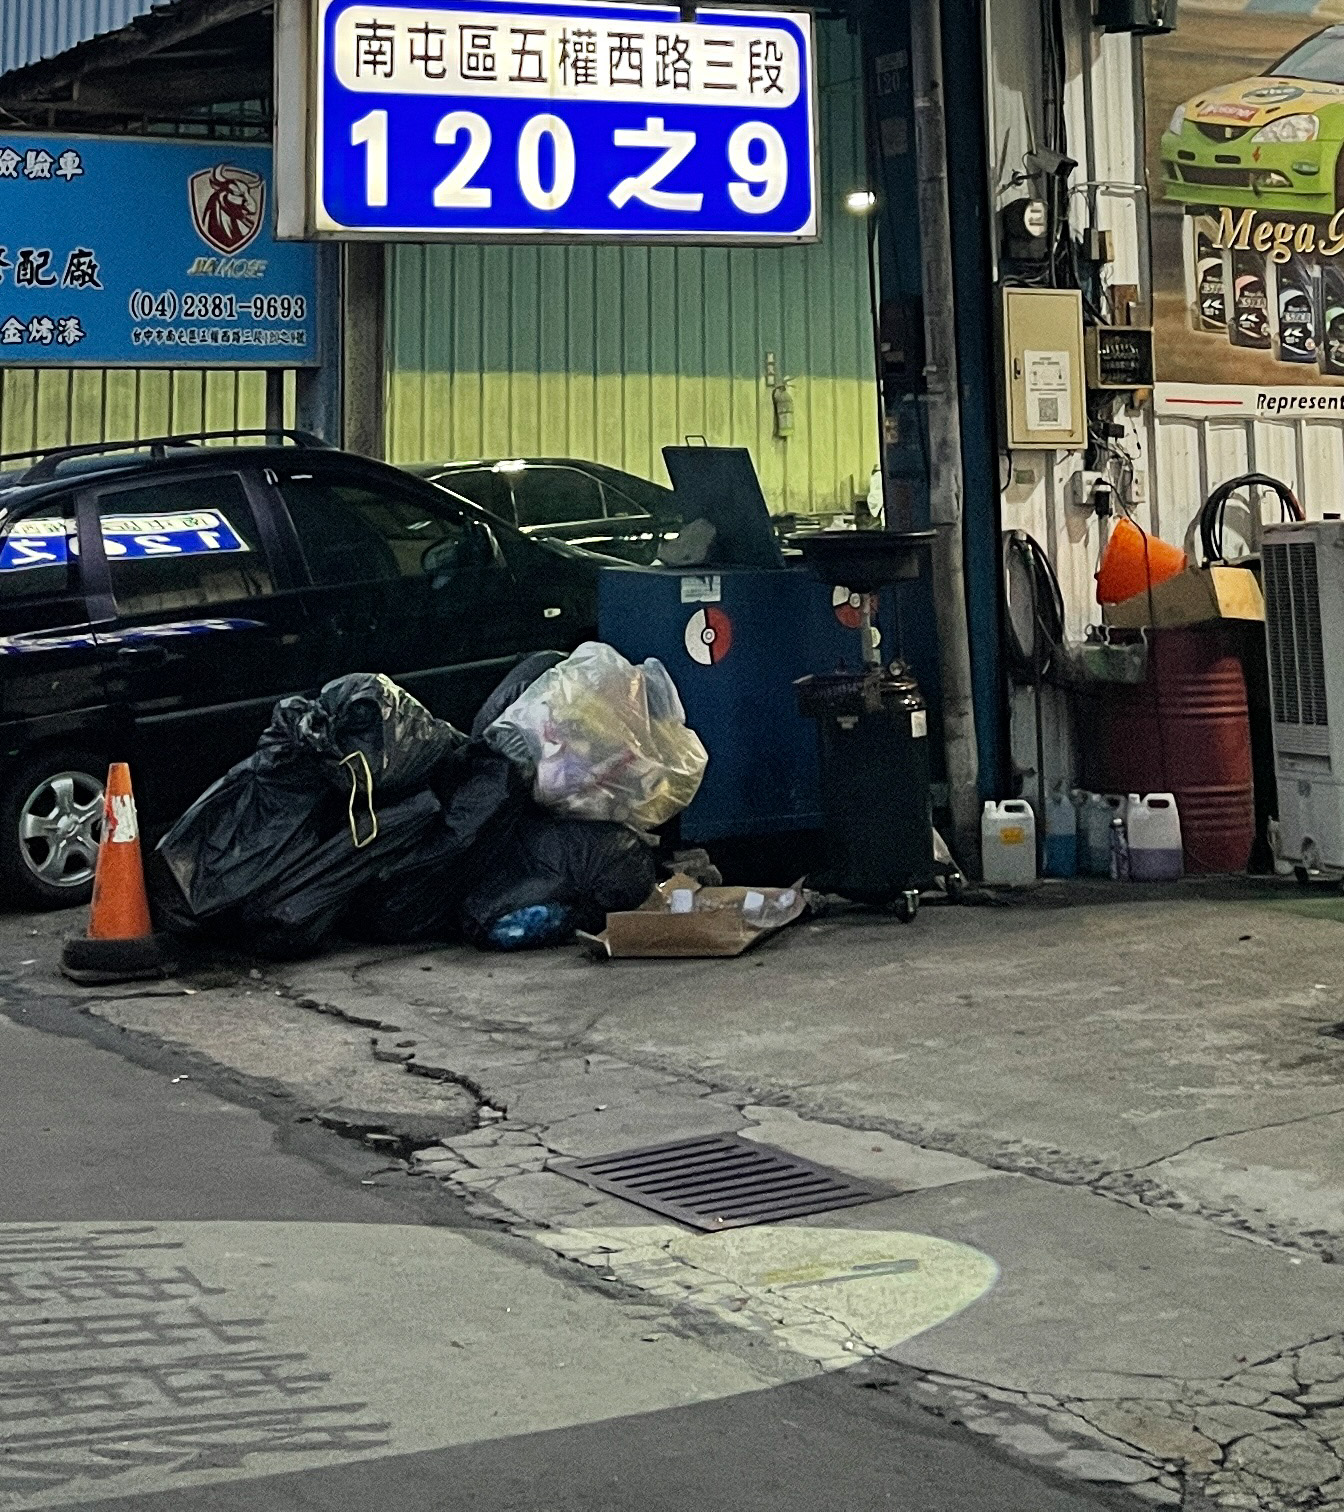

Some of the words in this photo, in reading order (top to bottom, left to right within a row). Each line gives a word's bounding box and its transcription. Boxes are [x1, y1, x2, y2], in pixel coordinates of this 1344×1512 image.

[353, 17, 786, 96] 南屯區五權西路三段
[349, 108, 789, 216] 120之9
